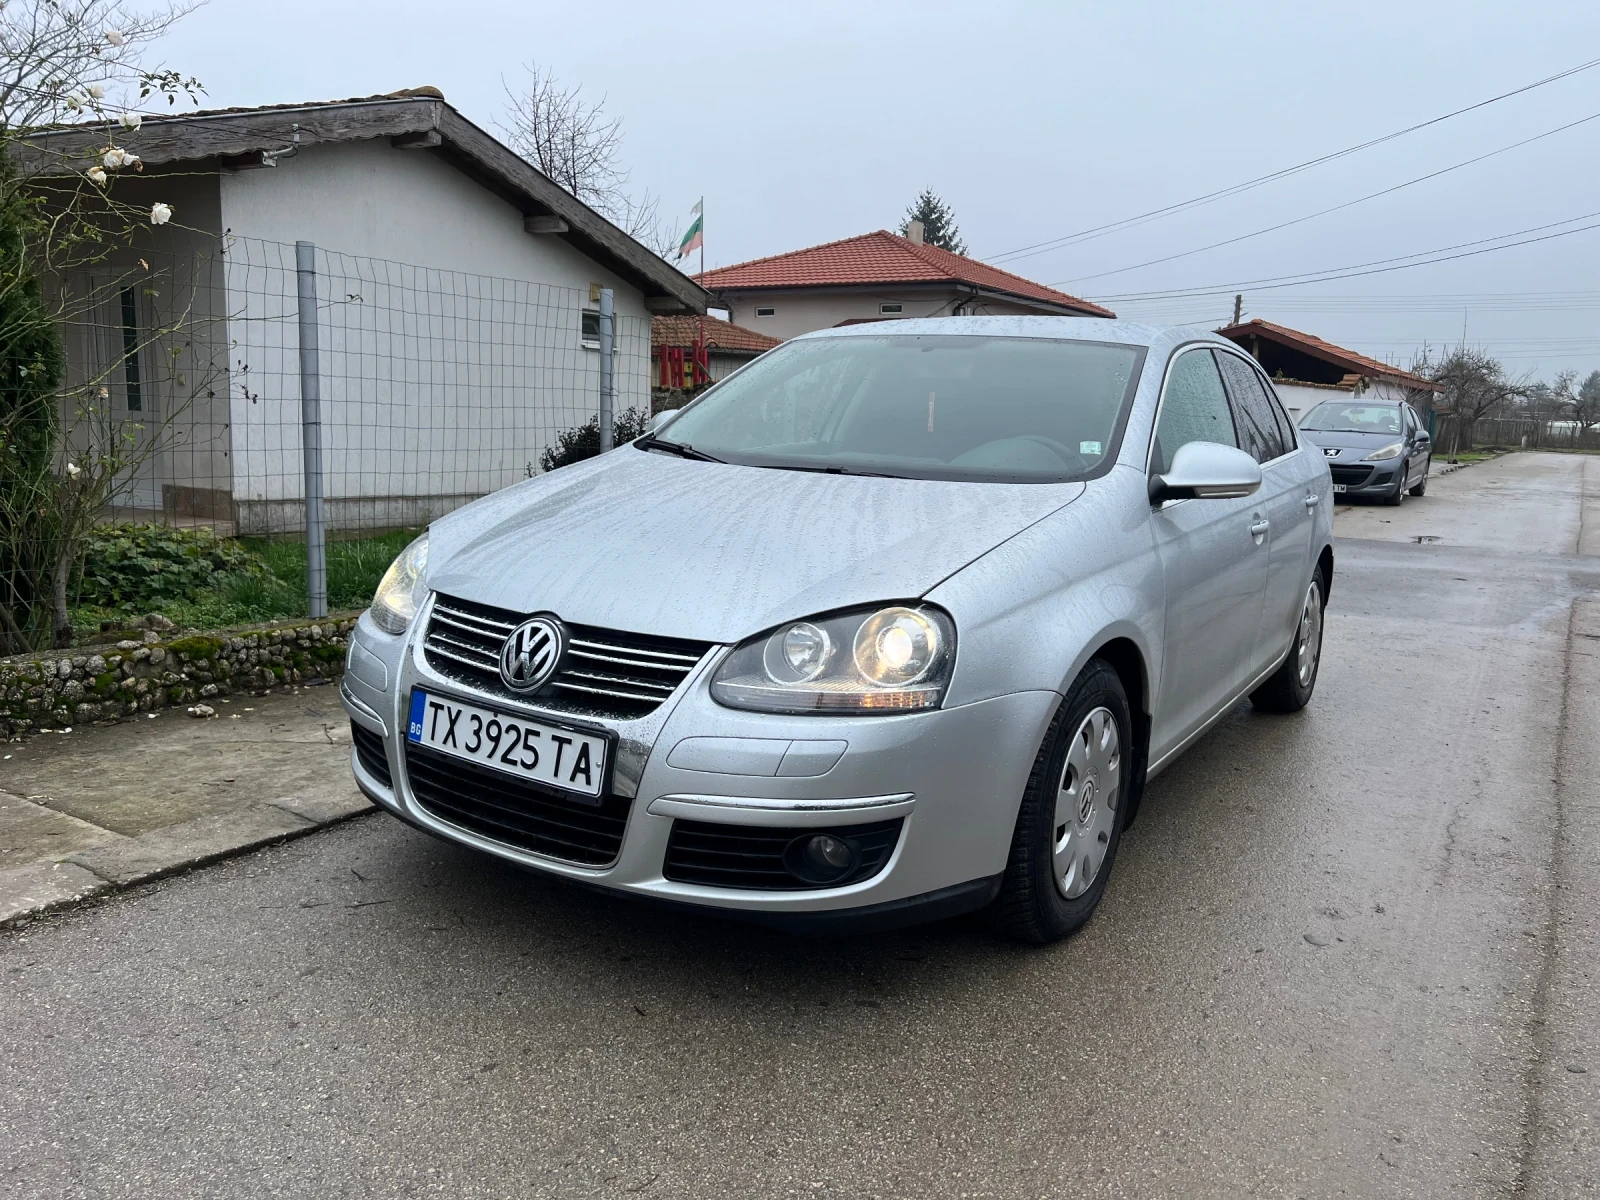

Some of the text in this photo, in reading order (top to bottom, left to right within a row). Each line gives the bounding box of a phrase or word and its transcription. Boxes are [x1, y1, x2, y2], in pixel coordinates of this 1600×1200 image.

[503, 621, 557, 686] VW
[410, 721, 421, 735] BG
[429, 701, 591, 787] TX 3925 TA
